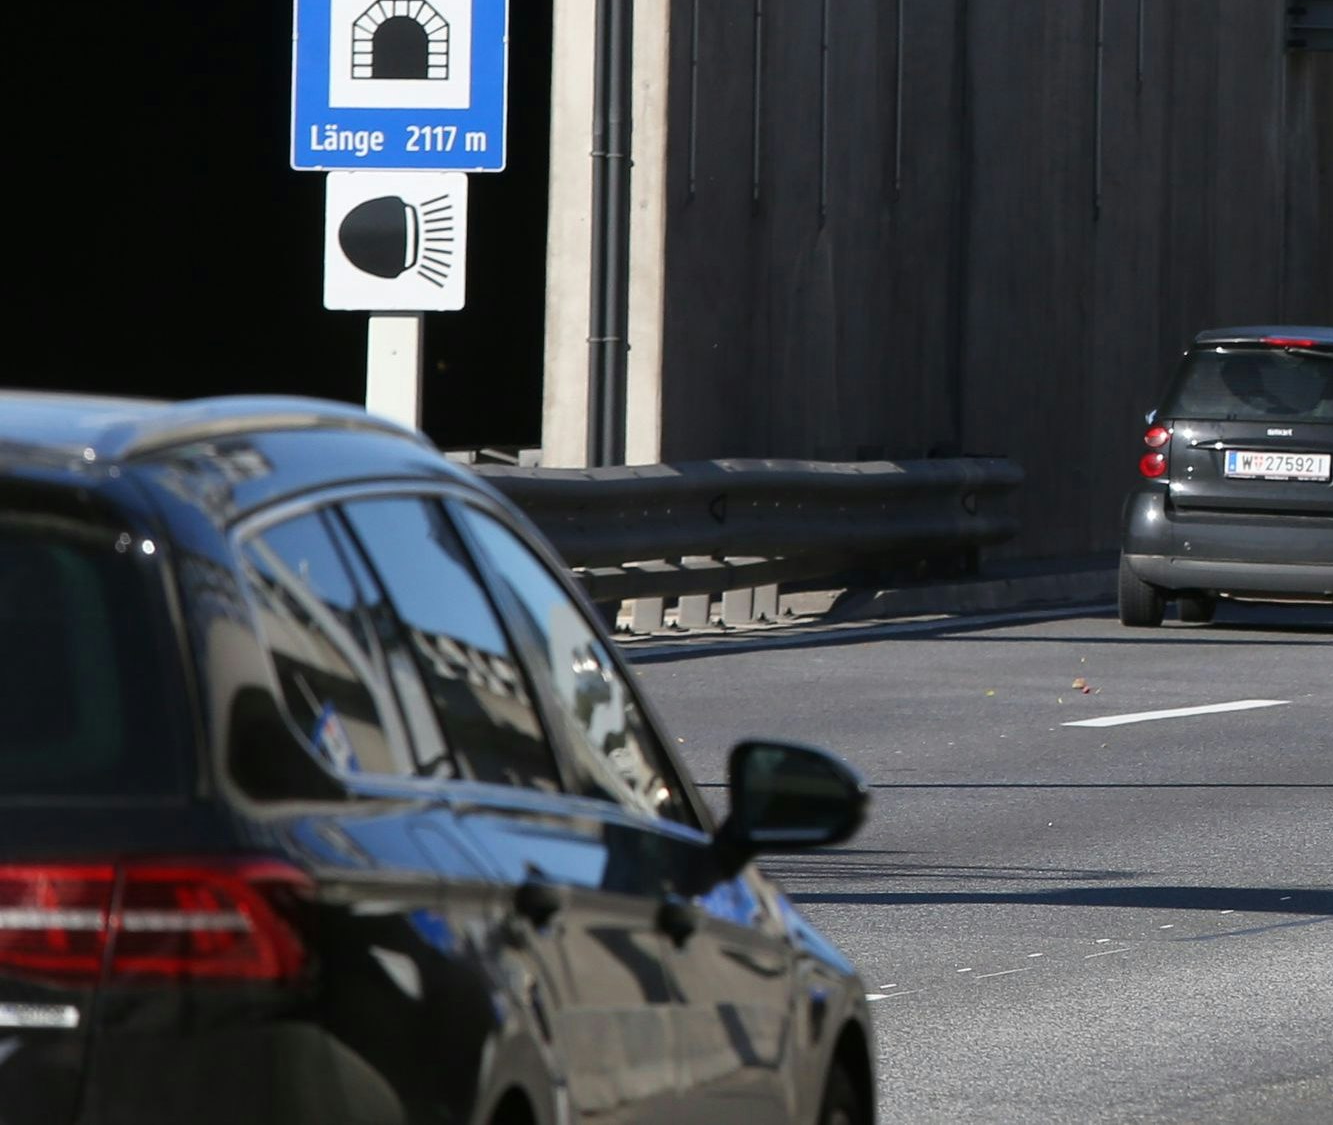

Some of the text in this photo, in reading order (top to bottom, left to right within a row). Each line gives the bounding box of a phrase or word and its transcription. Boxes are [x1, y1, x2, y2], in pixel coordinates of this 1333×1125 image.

[311, 125, 487, 156] Länge 2117 m
[1242, 455, 1253, 470] W
